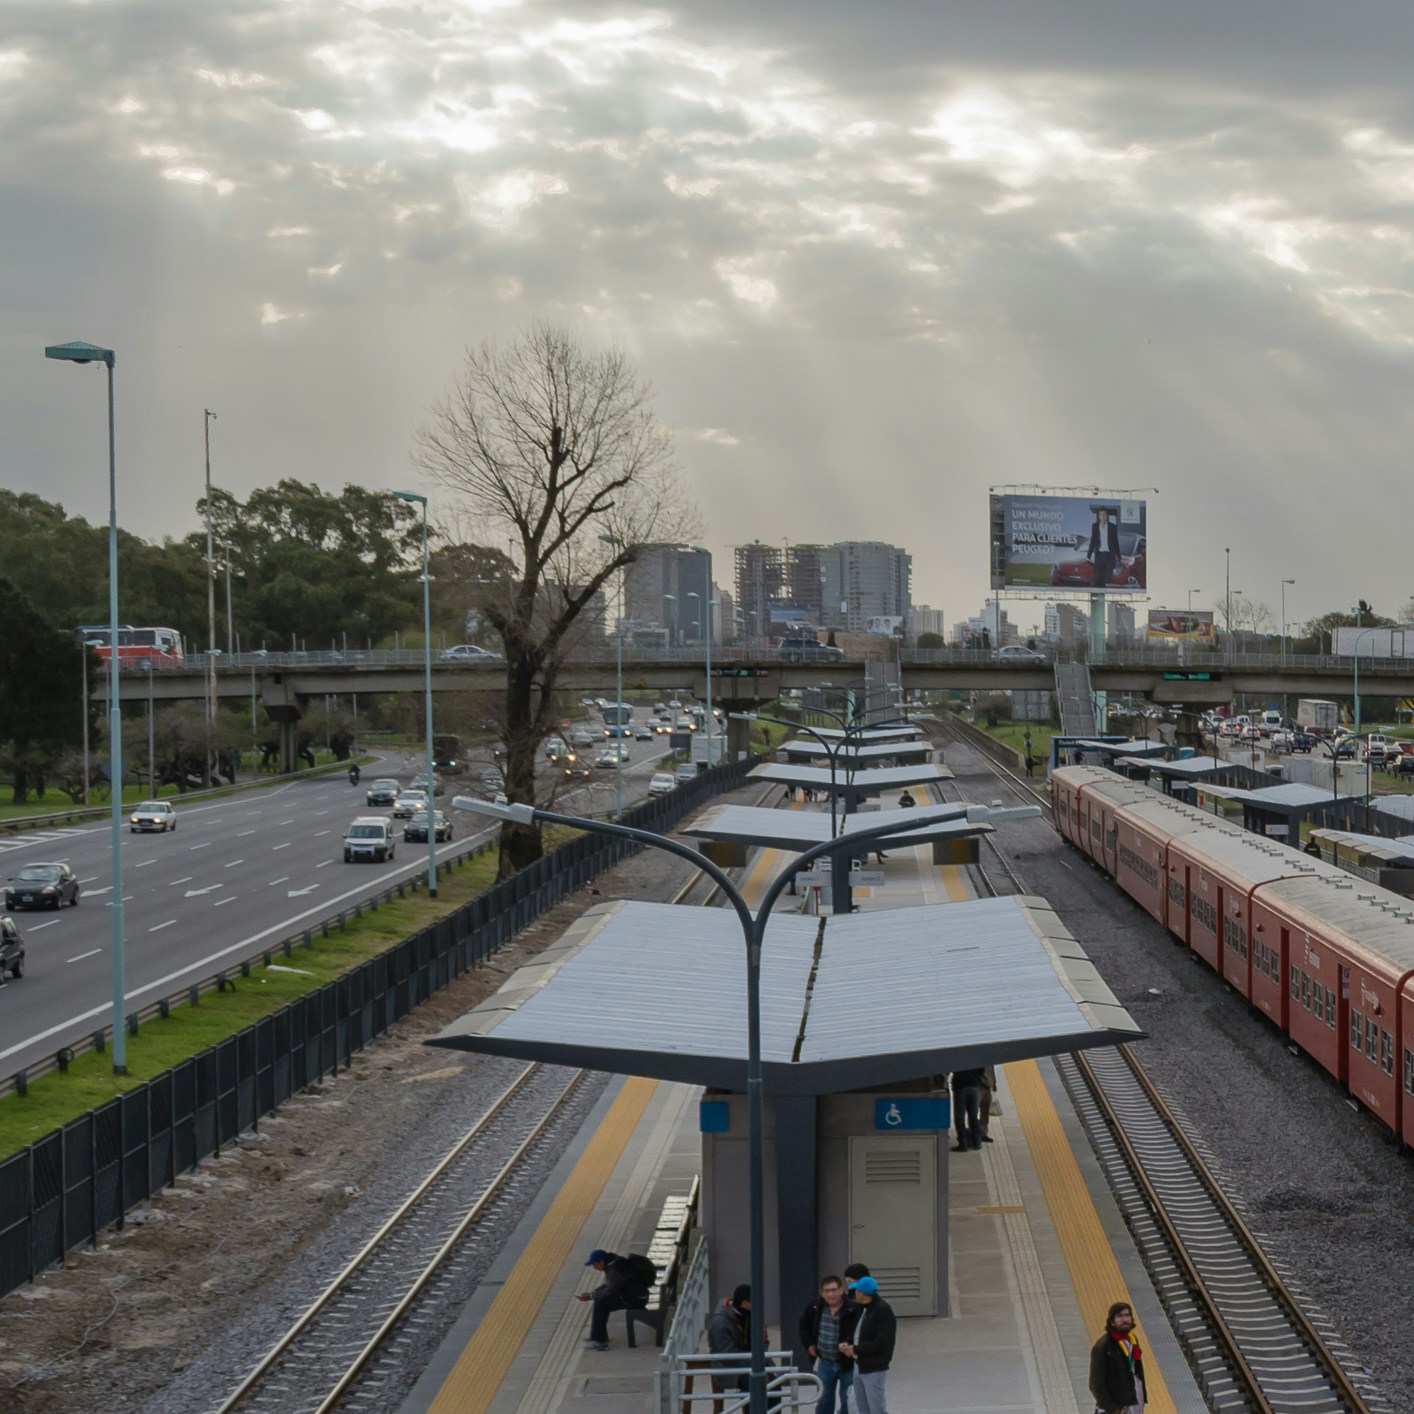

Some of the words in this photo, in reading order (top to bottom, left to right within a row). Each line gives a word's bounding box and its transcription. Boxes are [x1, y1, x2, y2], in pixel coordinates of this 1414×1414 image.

[1012, 510, 1026, 520] UN
[1028, 510, 1065, 521] MUNDO
[1012, 521, 1062, 532] EXCLUSIVO
[1012, 532, 1036, 543] PARA
[1036, 534, 1078, 545] CLIENTES
[1012, 544, 1055, 554] PEUGEOT
